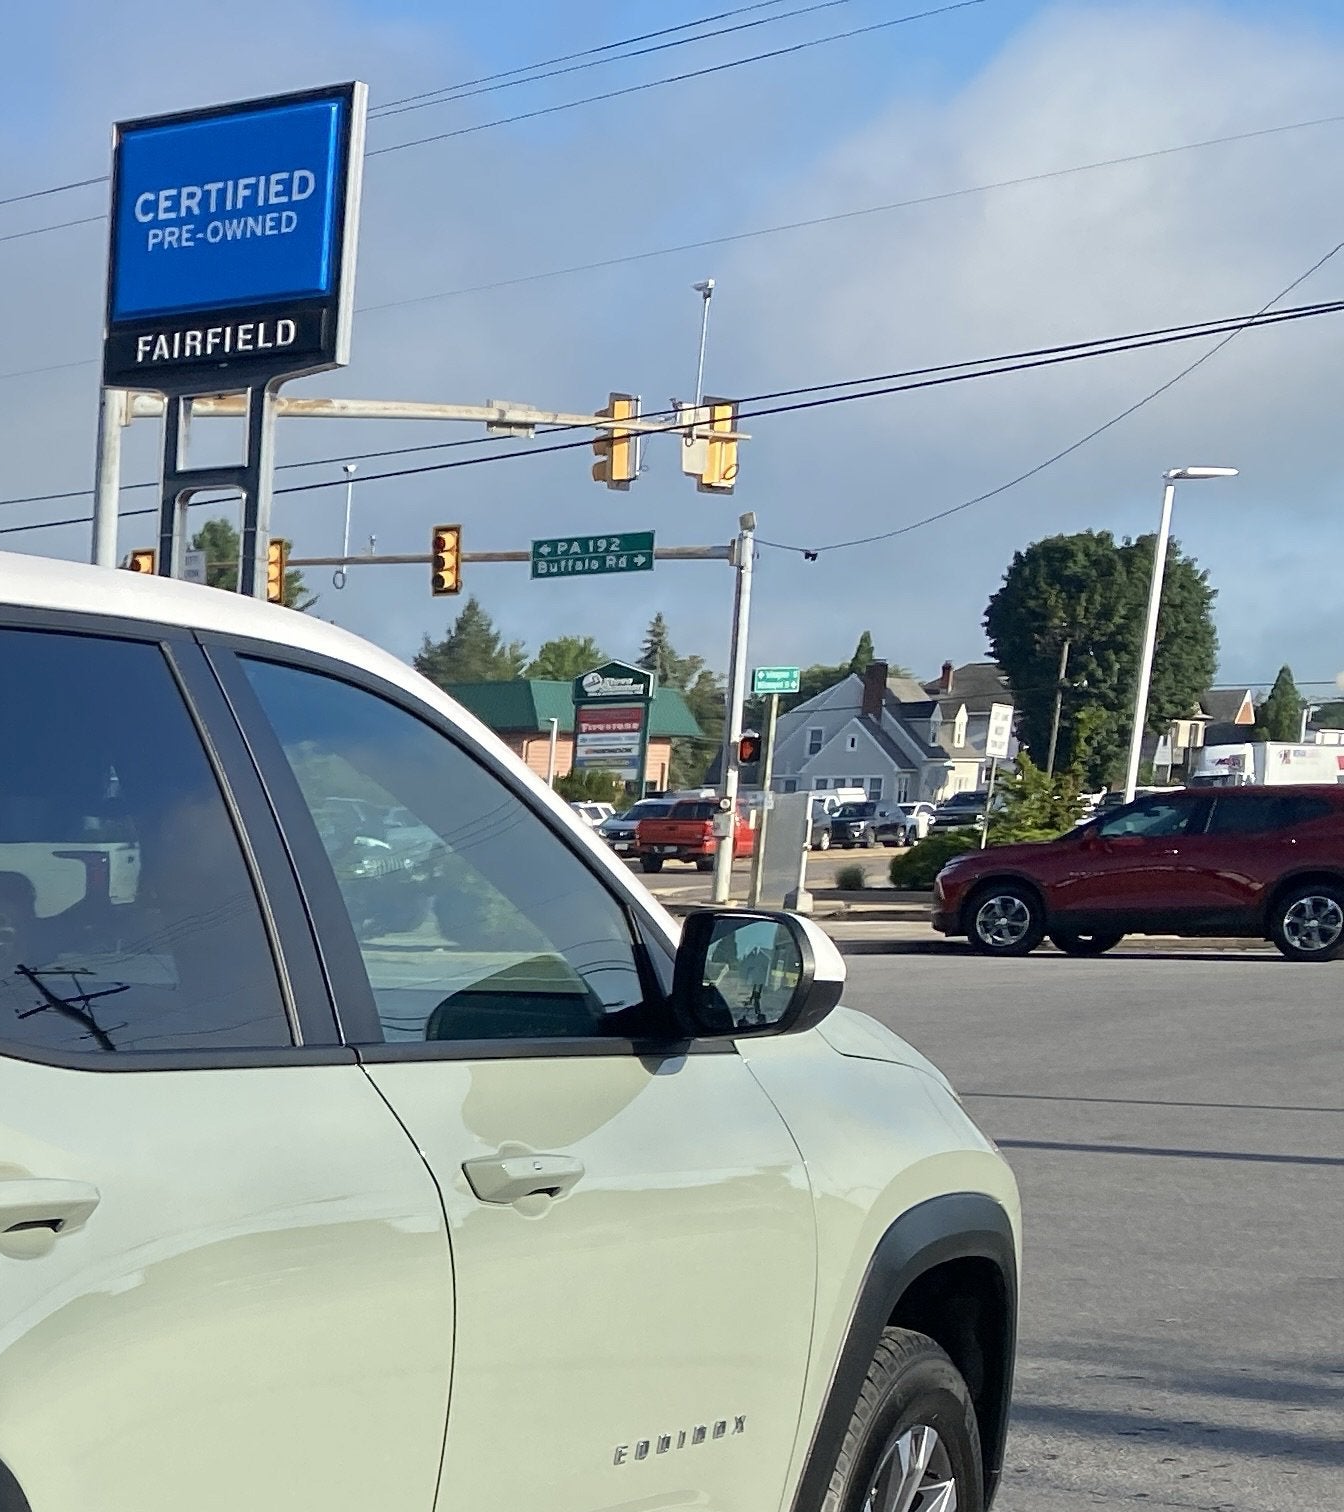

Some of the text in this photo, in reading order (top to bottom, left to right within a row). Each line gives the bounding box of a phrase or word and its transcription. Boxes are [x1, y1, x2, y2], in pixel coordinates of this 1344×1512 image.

[134, 169, 315, 223] CERTIFIED
[147, 210, 298, 252] PRE-OWNED
[136, 318, 296, 364] FAIRFIELD
[537, 555, 628, 574] Buffalo Rd
[557, 537, 621, 555] PA 192
[613, 1414, 748, 1466] EQUINOX
